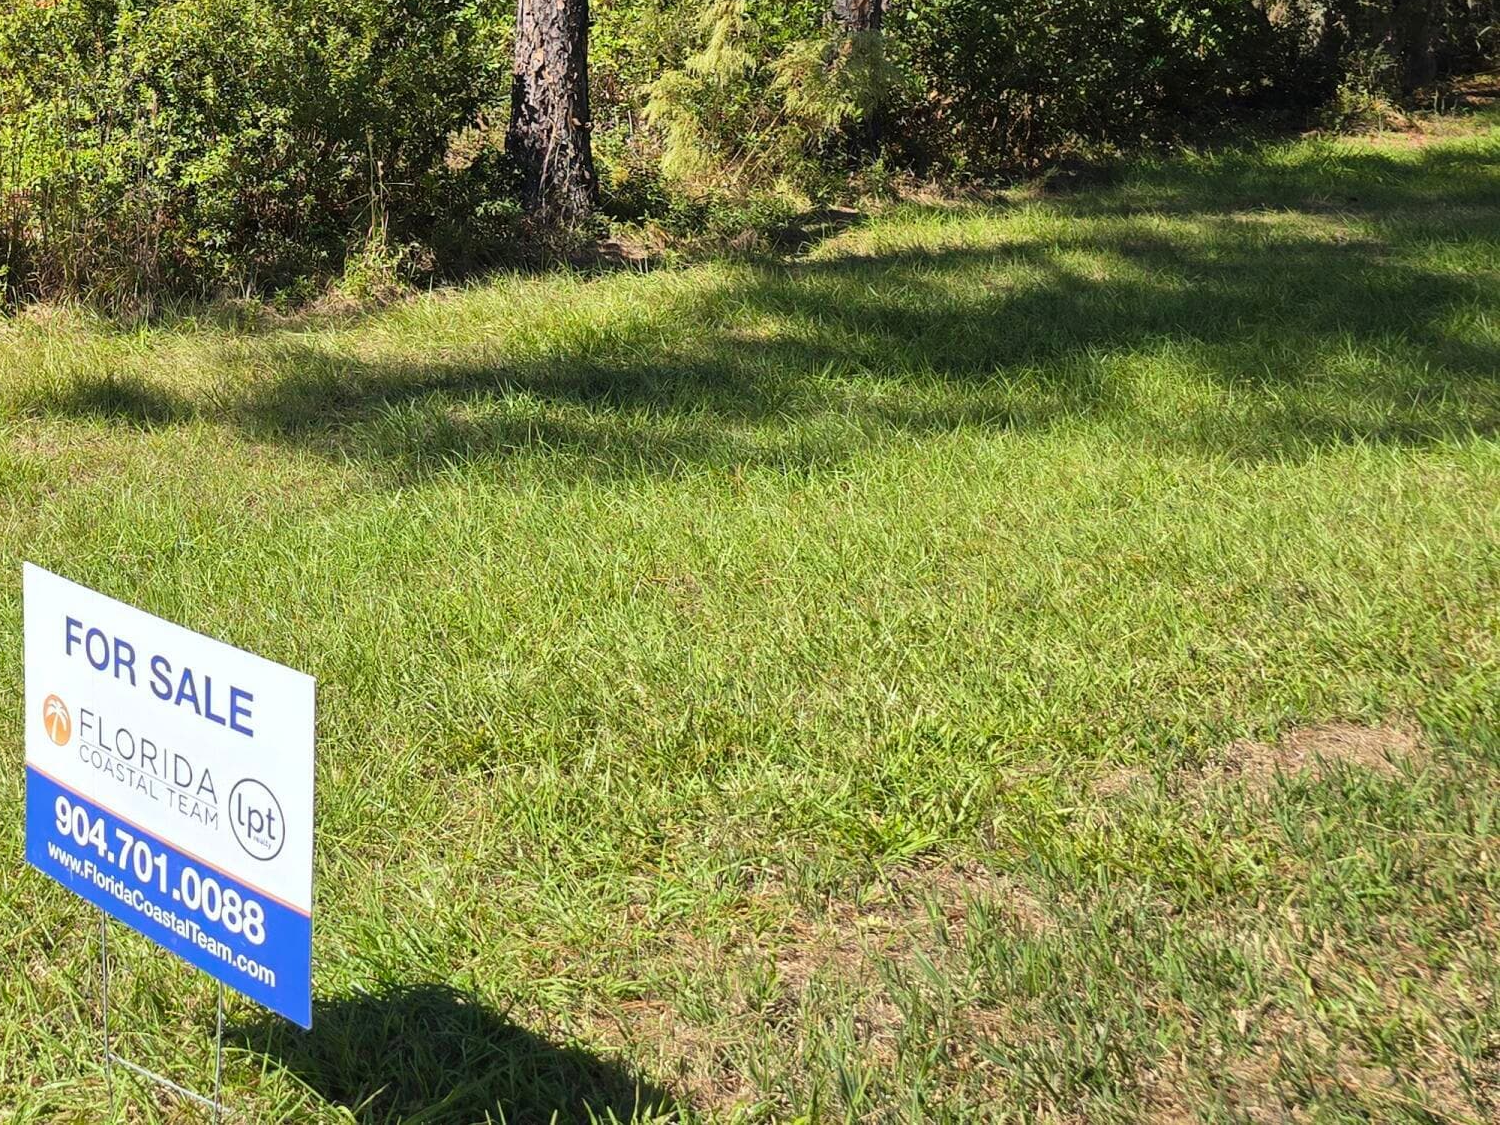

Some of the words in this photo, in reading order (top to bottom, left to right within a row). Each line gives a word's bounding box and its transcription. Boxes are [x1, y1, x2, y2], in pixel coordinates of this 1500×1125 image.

[65, 615, 136, 687] FOR
[150, 655, 254, 738] SALE
[79, 744, 159, 801] COASTAL
[167, 787, 219, 831] TEAM
[80, 708, 218, 804] FLORIDA
[54, 795, 266, 945] 904.701.0088
[238, 792, 276, 840] lpt
[48, 841, 276, 988] www.FloridaCoastalTeam.com
